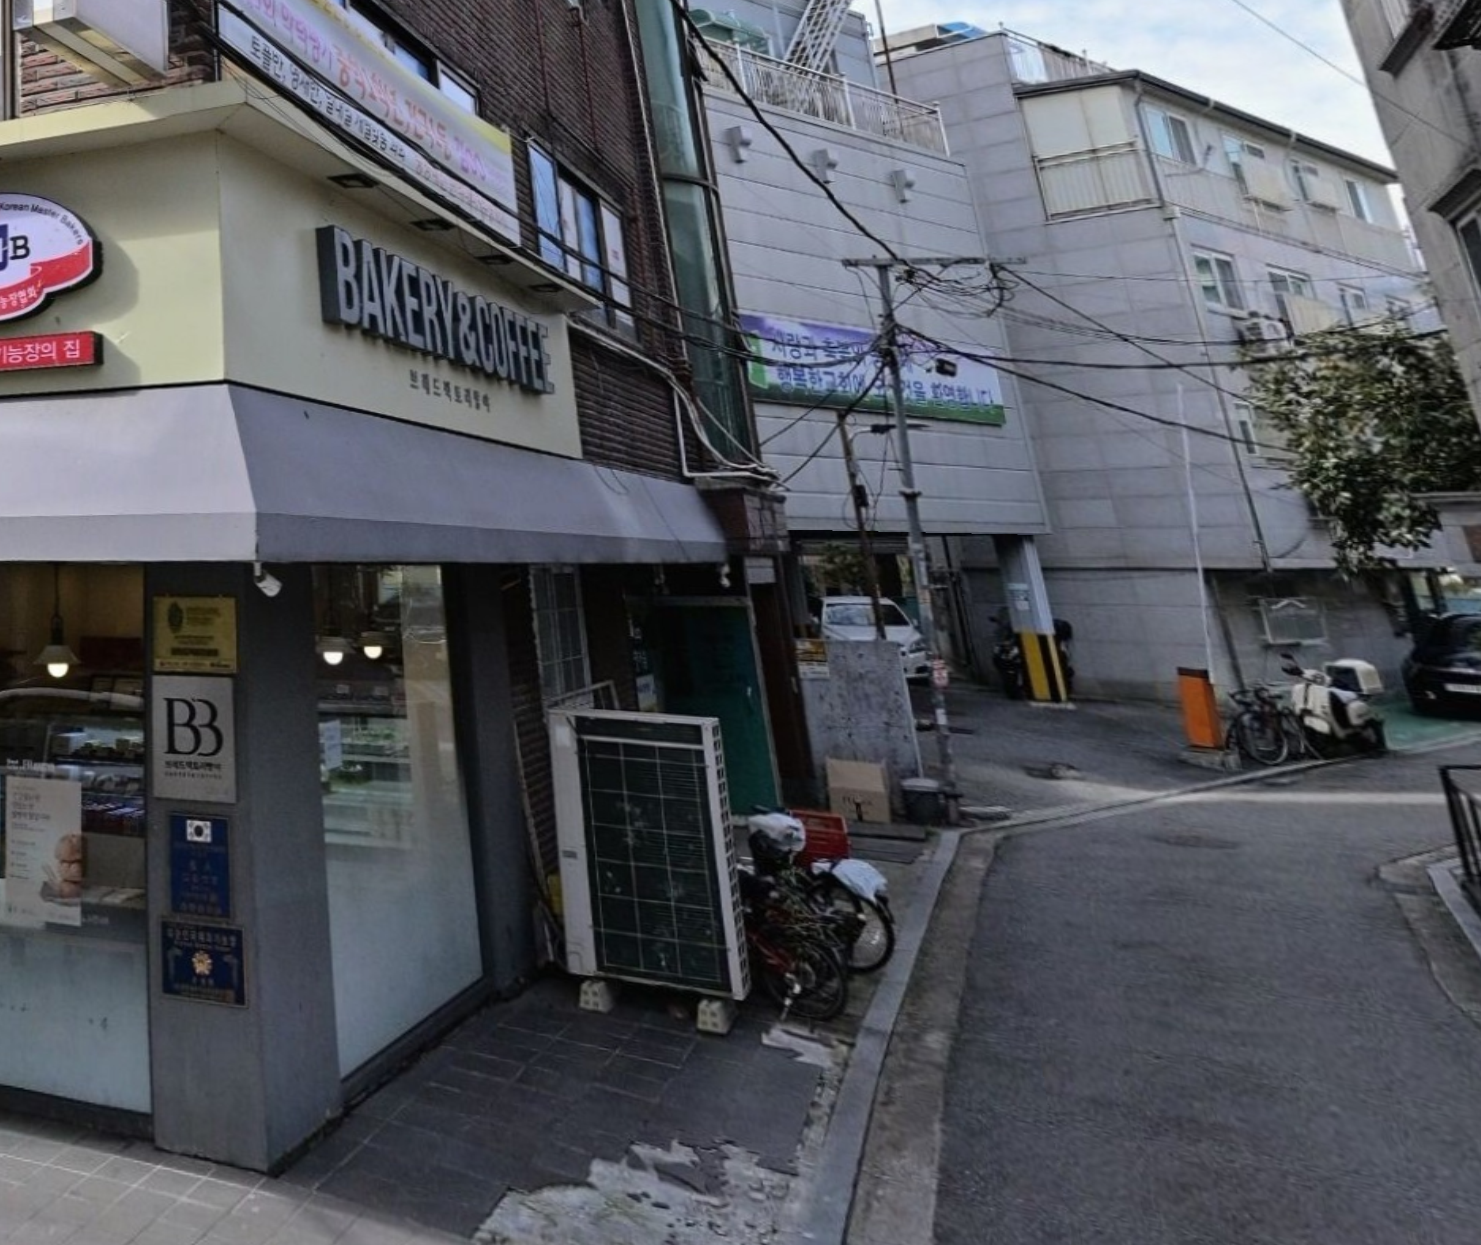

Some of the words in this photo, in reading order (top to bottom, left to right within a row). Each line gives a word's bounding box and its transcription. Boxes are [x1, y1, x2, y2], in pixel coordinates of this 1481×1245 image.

[30, 203, 60, 219] Master
[59, 214, 84, 246] Bakers
[318, 225, 555, 395] BAKERY&COFFEE
[62, 339, 81, 359] 집
